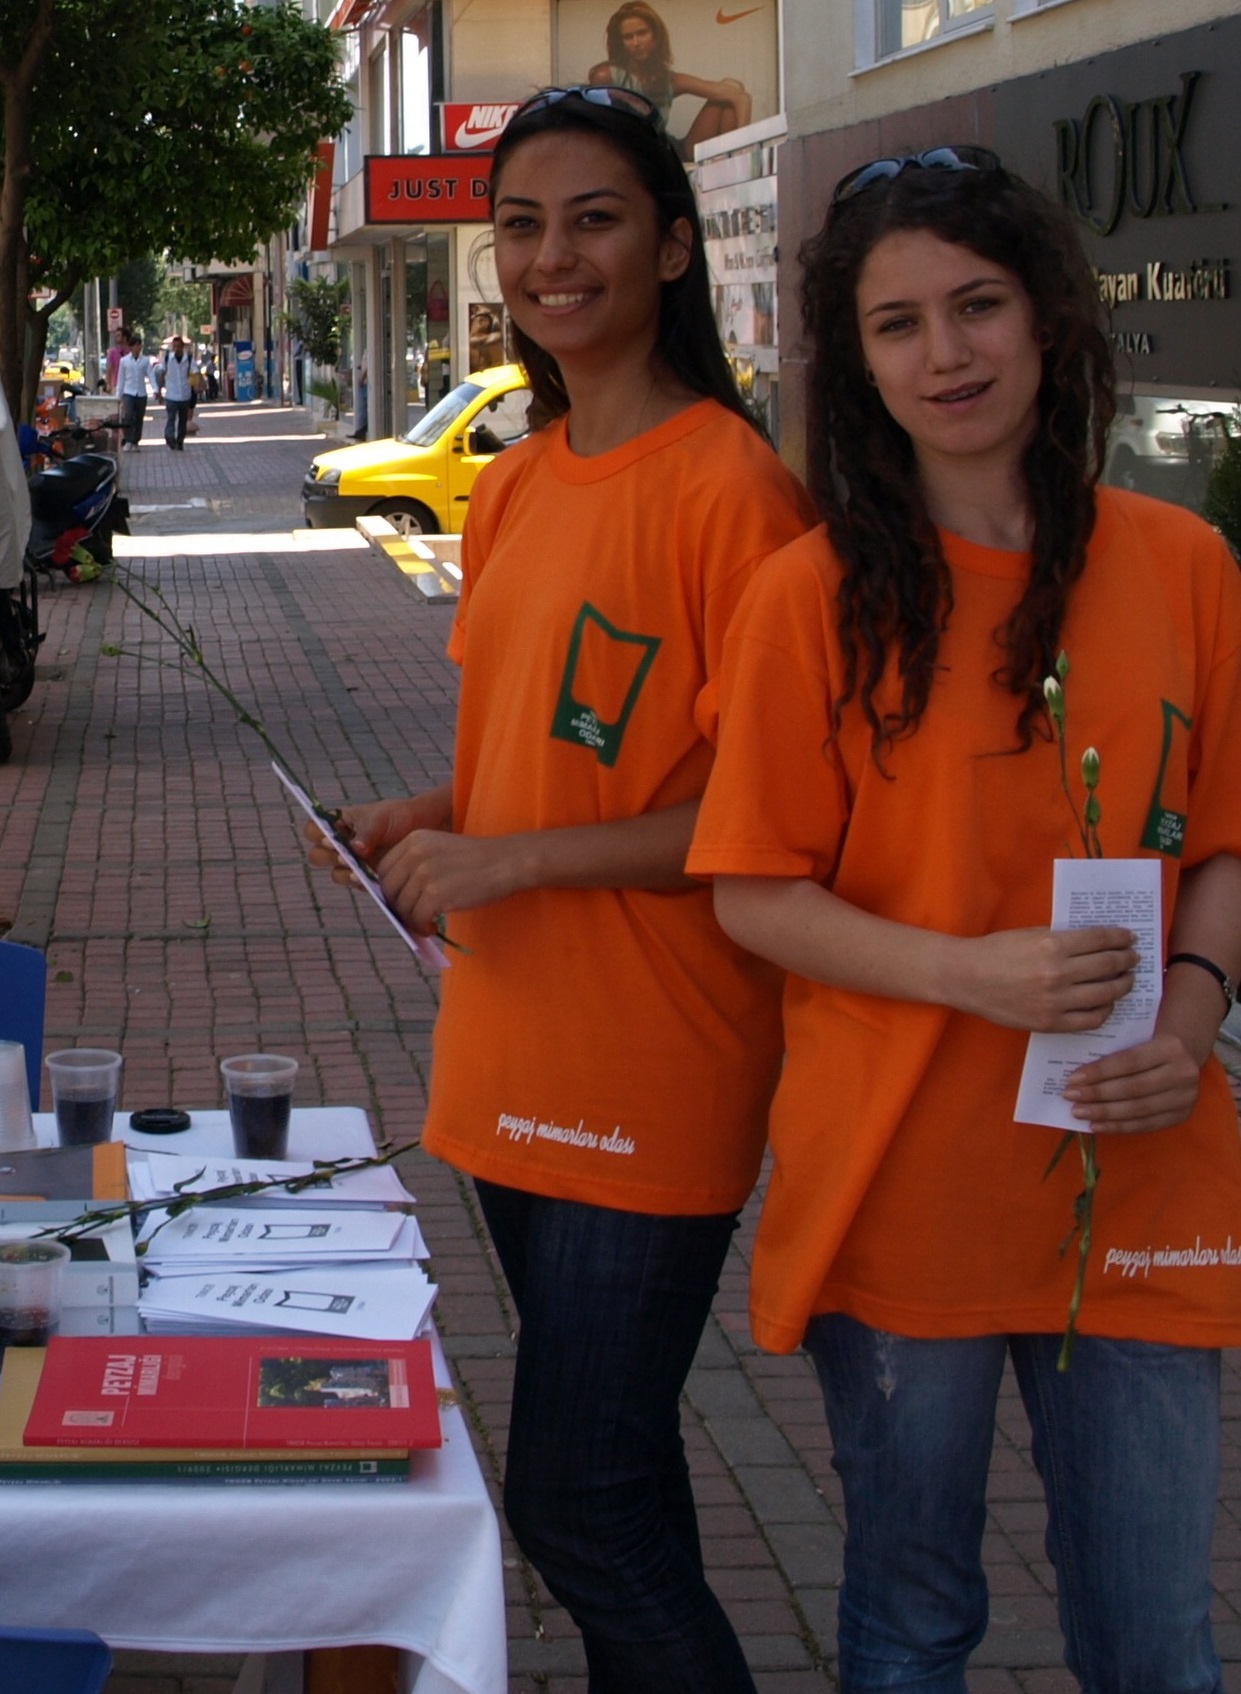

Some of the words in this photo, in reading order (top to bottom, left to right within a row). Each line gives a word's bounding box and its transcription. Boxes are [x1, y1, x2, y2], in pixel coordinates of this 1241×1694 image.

[388, 178, 458, 200] JUST
[471, 177, 490, 200] D
[1093, 266, 1139, 309] ayan
[496, 1113, 537, 1145] peyzaj
[536, 1119, 599, 1149] mimarları
[599, 1125, 636, 1155] odası
[1103, 1246, 1151, 1278] peyzaj
[1153, 1235, 1219, 1267] mimarları
[100, 1354, 137, 1396] PEYZAJ
[319, 1463, 354, 1472] PEYZAJ
